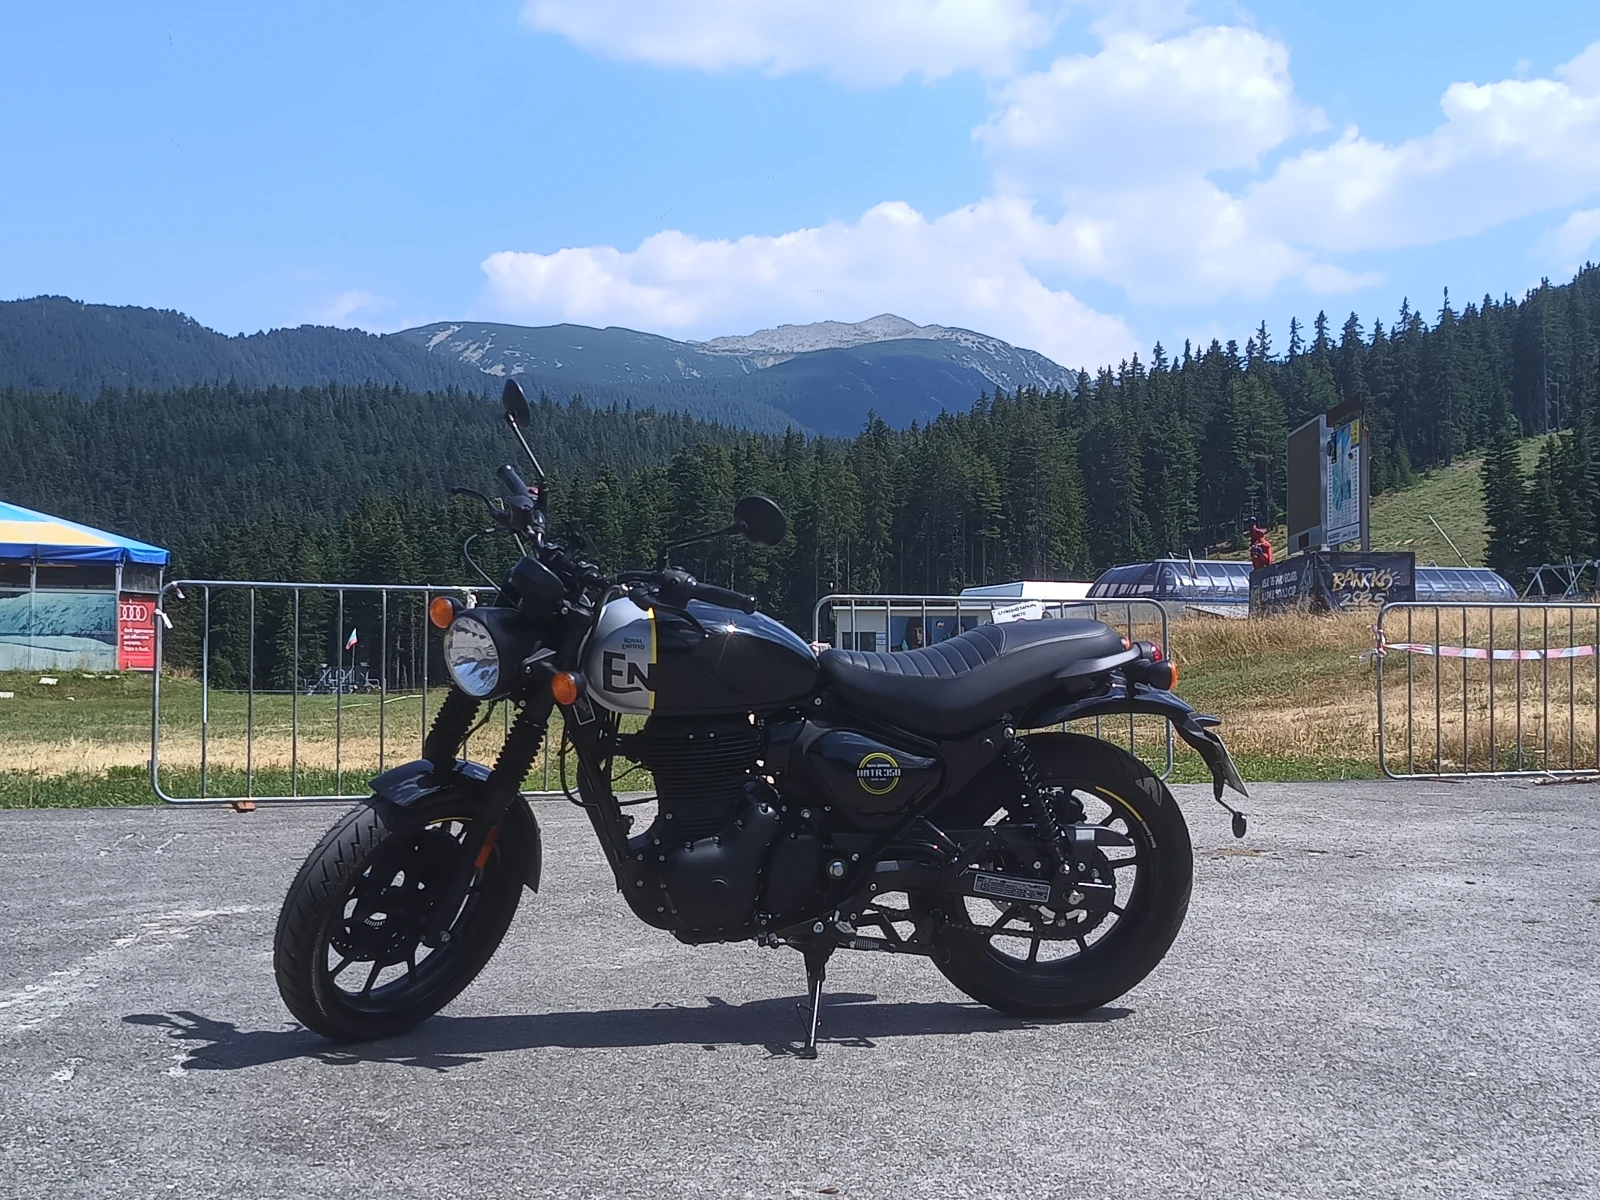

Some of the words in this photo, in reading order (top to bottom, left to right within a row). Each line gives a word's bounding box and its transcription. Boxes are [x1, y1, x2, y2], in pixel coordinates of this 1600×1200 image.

[1331, 568, 1393, 594] BANSKO
[1340, 590, 1386, 607] 2025
[603, 651, 658, 694] EN
